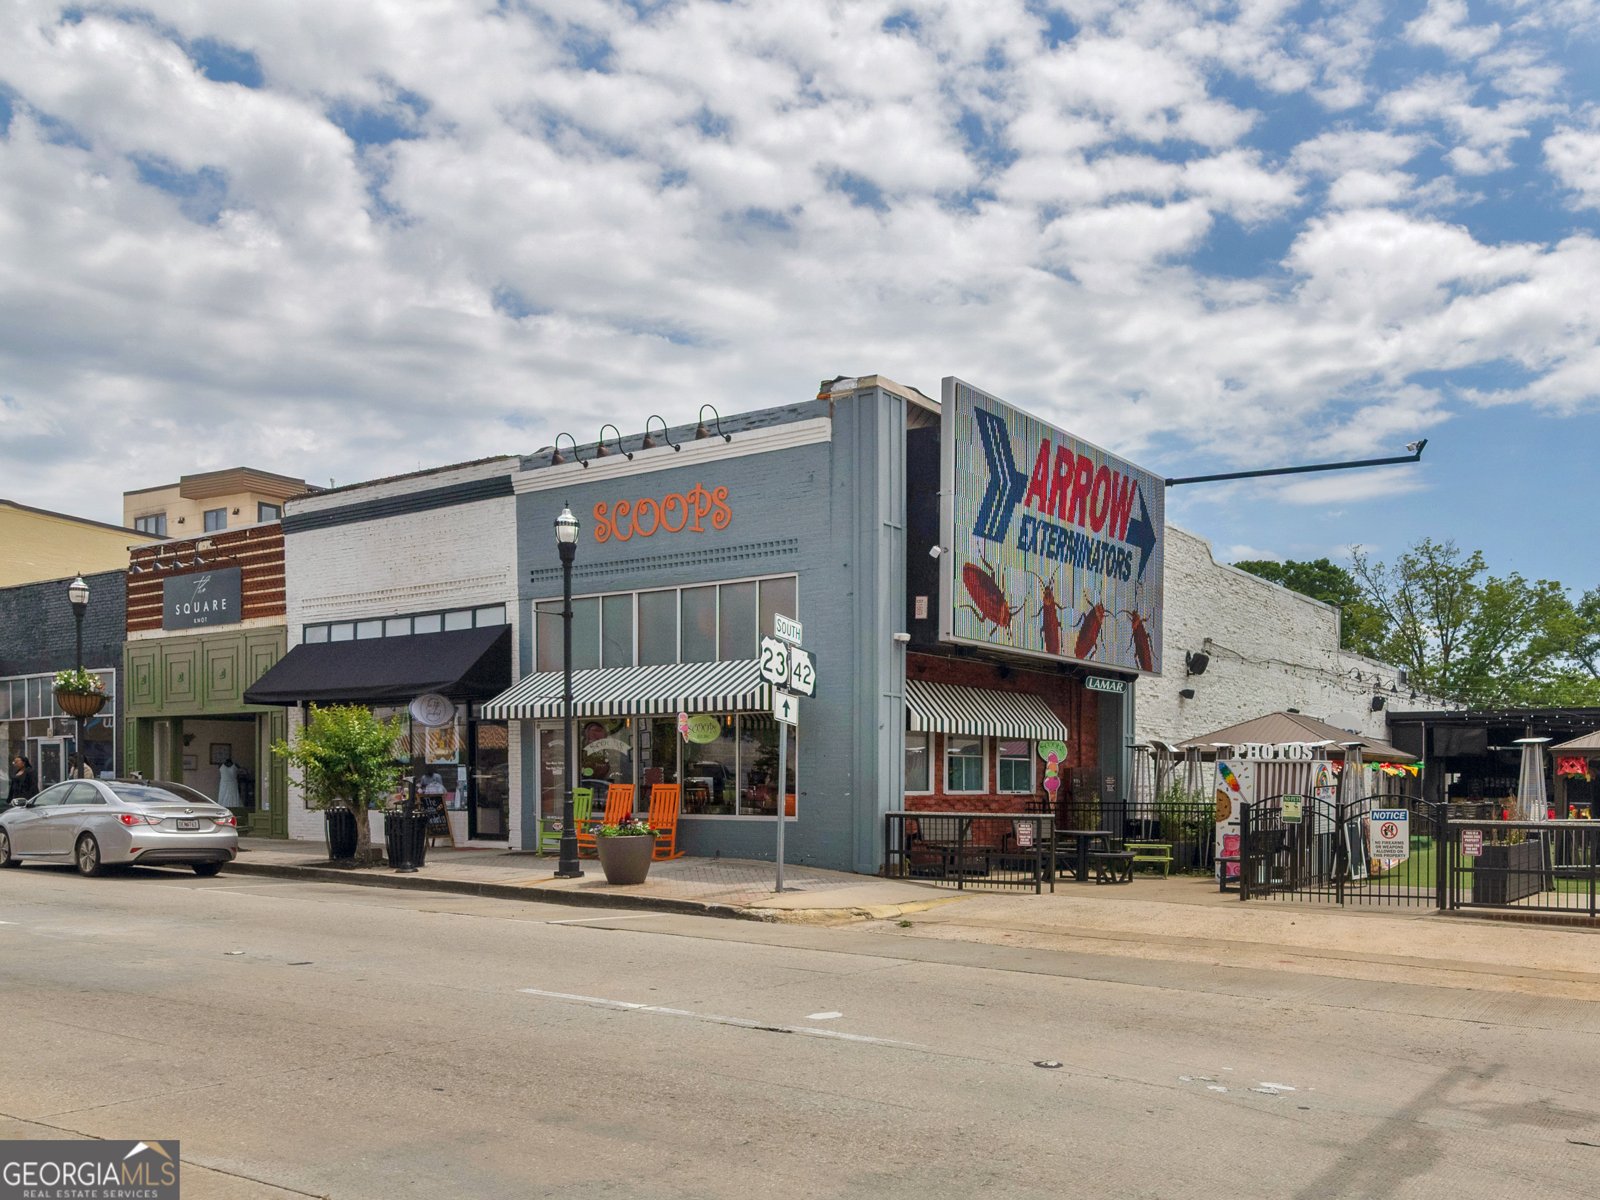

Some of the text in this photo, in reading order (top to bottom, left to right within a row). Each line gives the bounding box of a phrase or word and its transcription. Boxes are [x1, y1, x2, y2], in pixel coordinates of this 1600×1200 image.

[1024, 438, 1138, 542] ARROW
[593, 482, 732, 543] SCOOPS
[1016, 513, 1133, 582] EXTERMINATORS
[175, 598, 227, 615] SQUARE
[776, 618, 800, 641] SOUTH
[763, 647, 785, 676] 23
[793, 662, 811, 685] 42
[1089, 678, 1124, 691] LAMAR
[1231, 743, 1313, 760] PHOTOS
[1373, 811, 1406, 820] NOTICE
